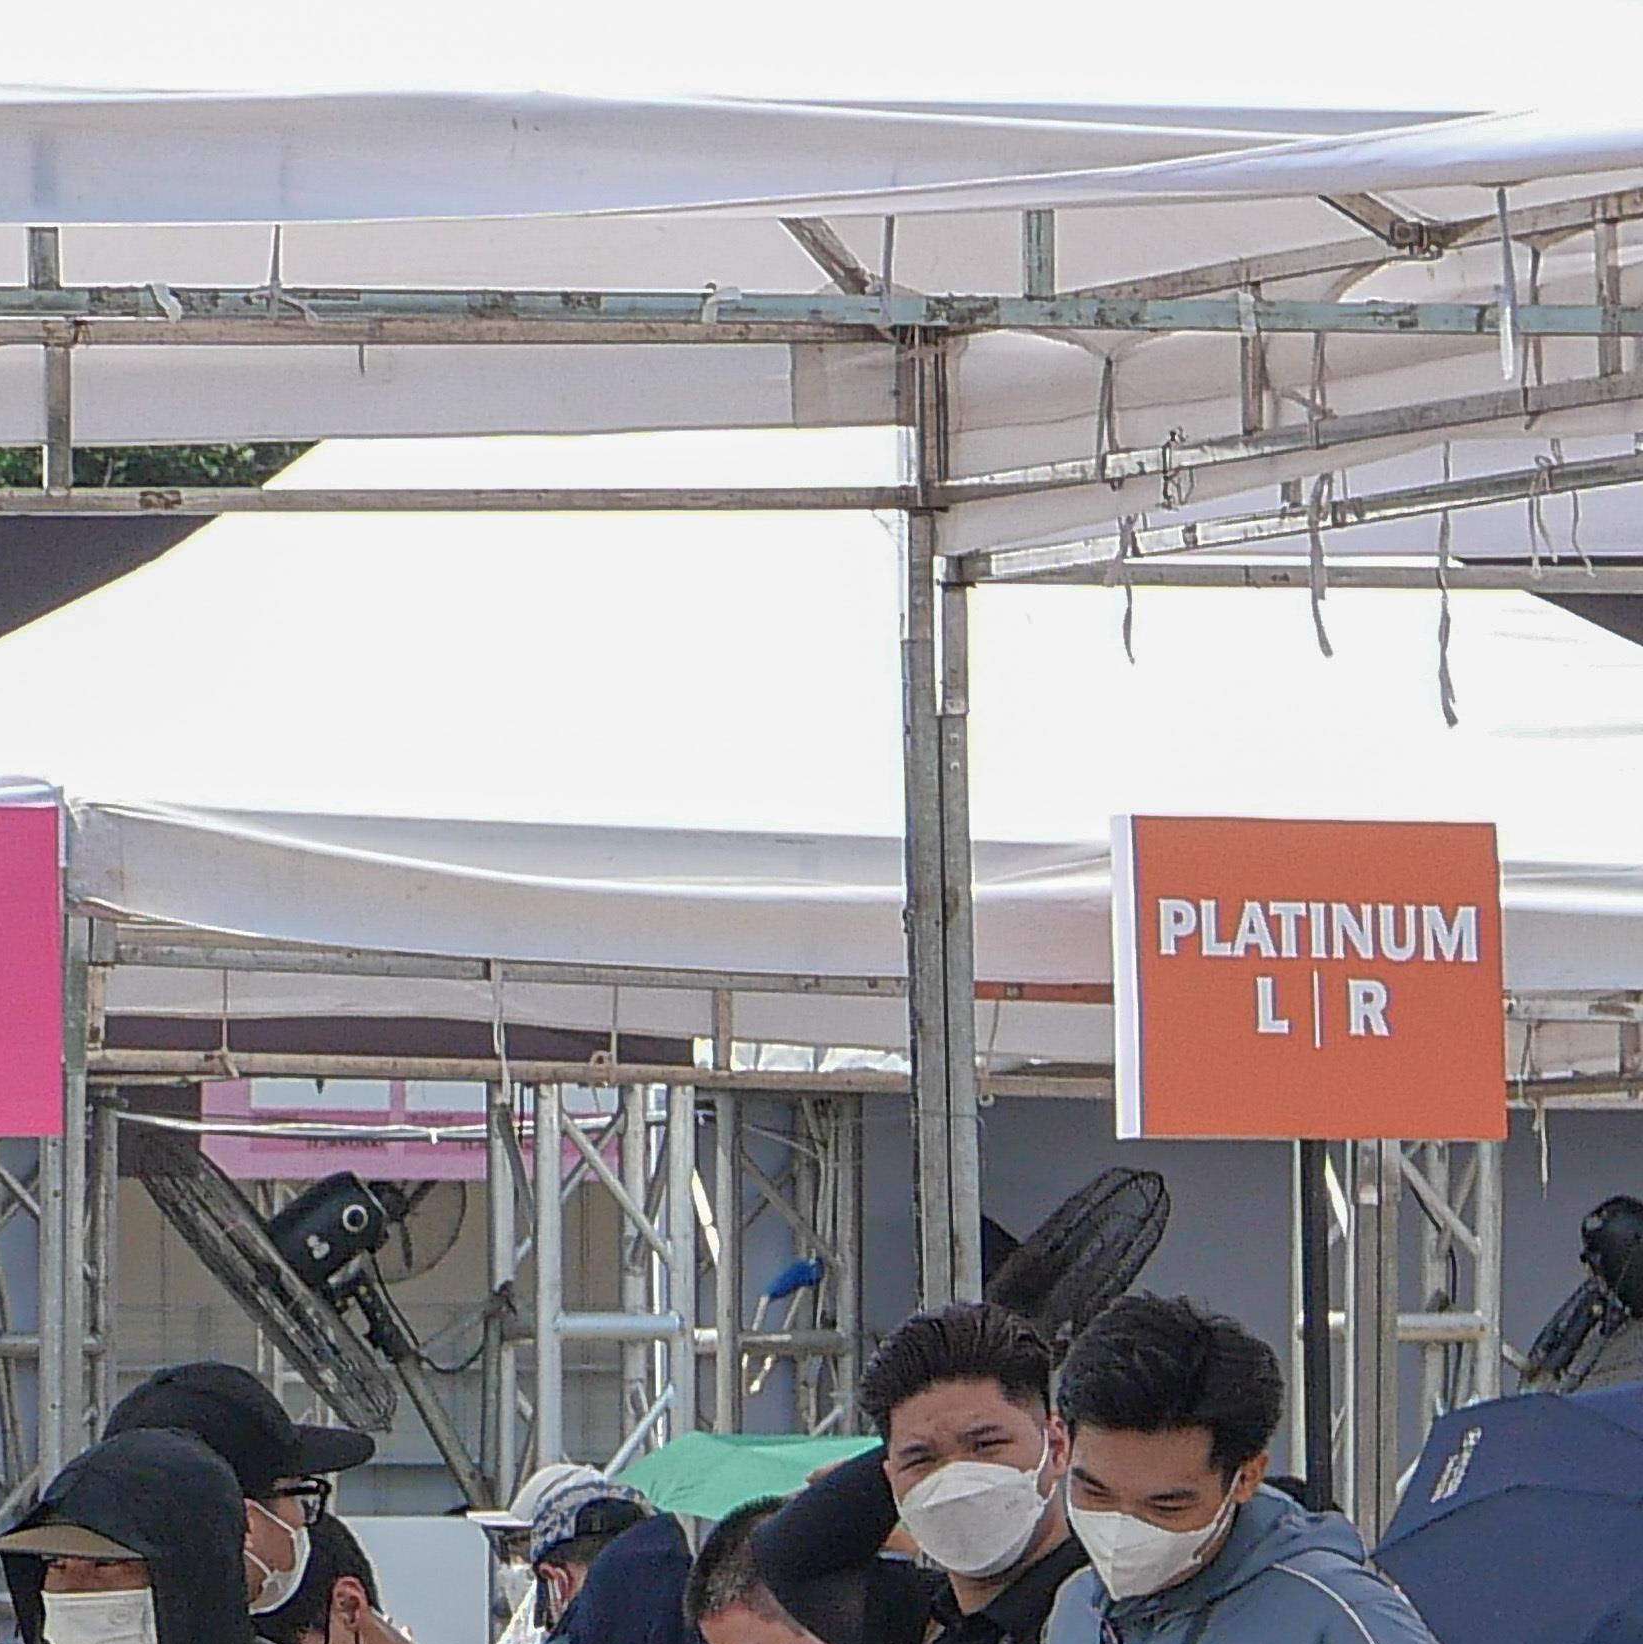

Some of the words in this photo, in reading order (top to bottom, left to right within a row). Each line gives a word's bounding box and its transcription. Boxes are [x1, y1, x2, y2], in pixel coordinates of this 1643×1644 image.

[1157, 897, 1482, 963] PLATINUM
[1254, 975, 1295, 1035] L
[1347, 978, 1392, 1037] R
